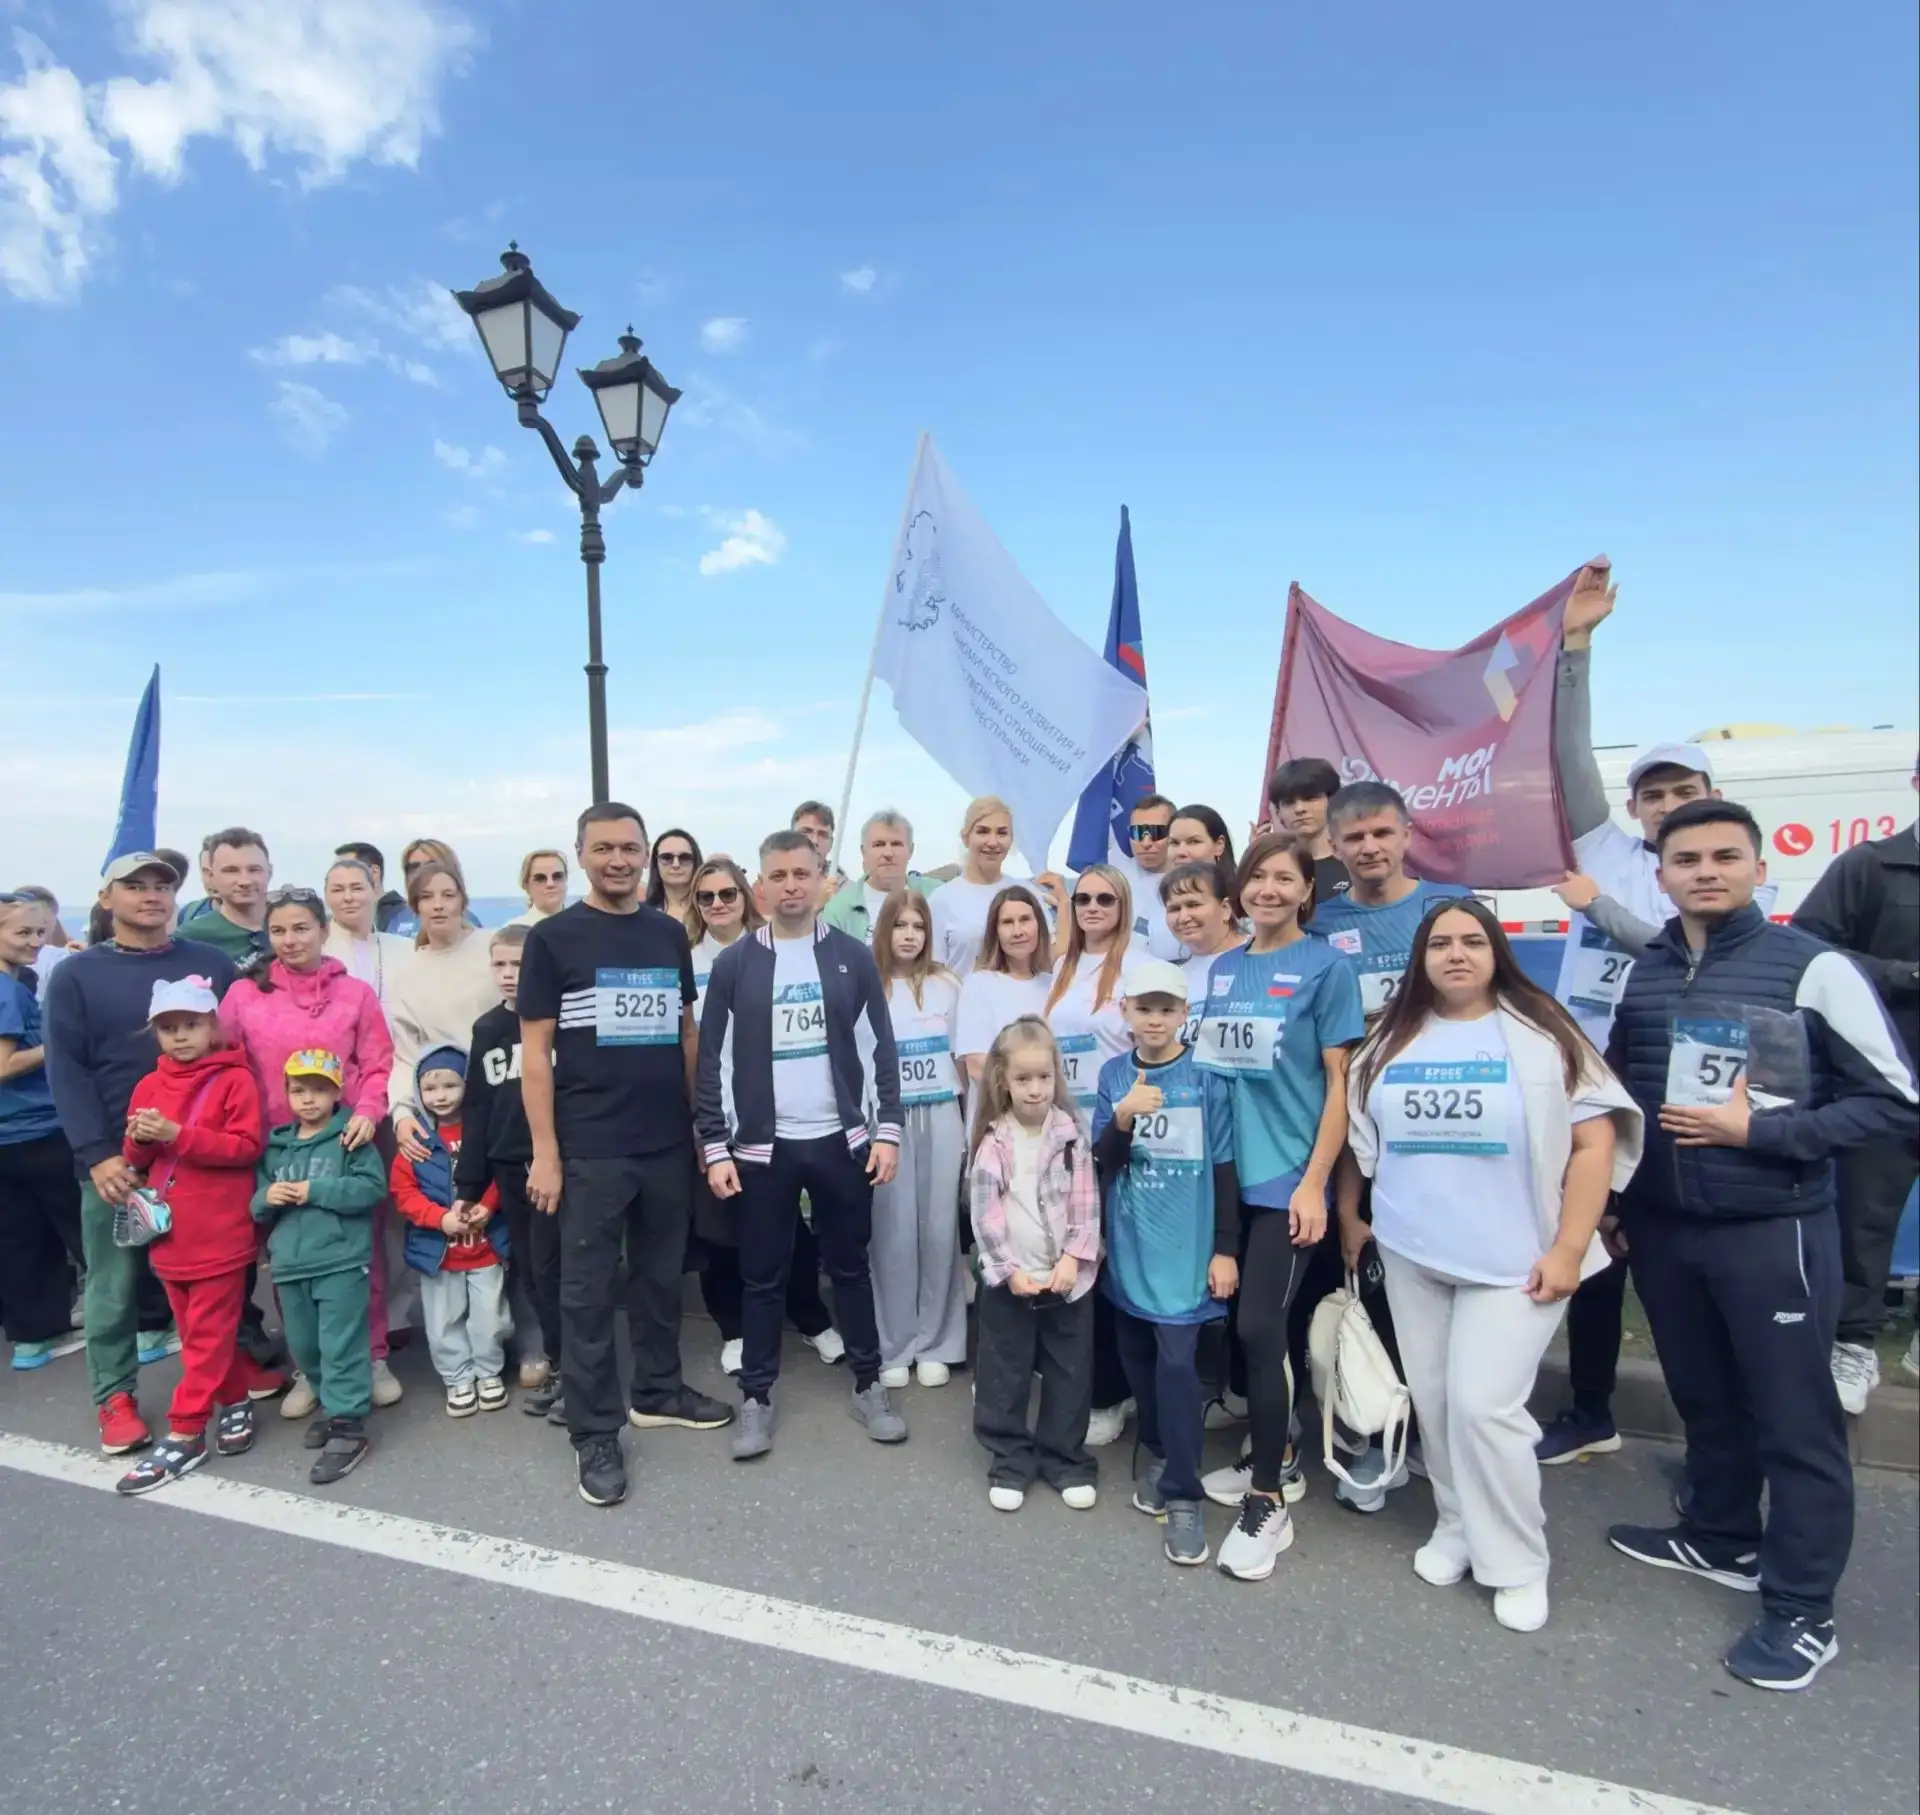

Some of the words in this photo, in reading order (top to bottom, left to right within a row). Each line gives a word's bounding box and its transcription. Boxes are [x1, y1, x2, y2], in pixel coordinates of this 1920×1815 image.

[950, 602, 1018, 675] МИНИСТЕРСТВО
[1004, 713, 1072, 775] ОТНОШЕНИЙ
[1020, 700, 1075, 750] РАЗВИТИЯ
[1072, 747, 1087, 760] И
[1828, 815, 1896, 854] 103
[615, 993, 667, 1018] 5225
[782, 1005, 825, 1033] 764
[1217, 1021, 1254, 1050] 716
[902, 1058, 937, 1081] 502
[1404, 1089, 1484, 1120] 5325
